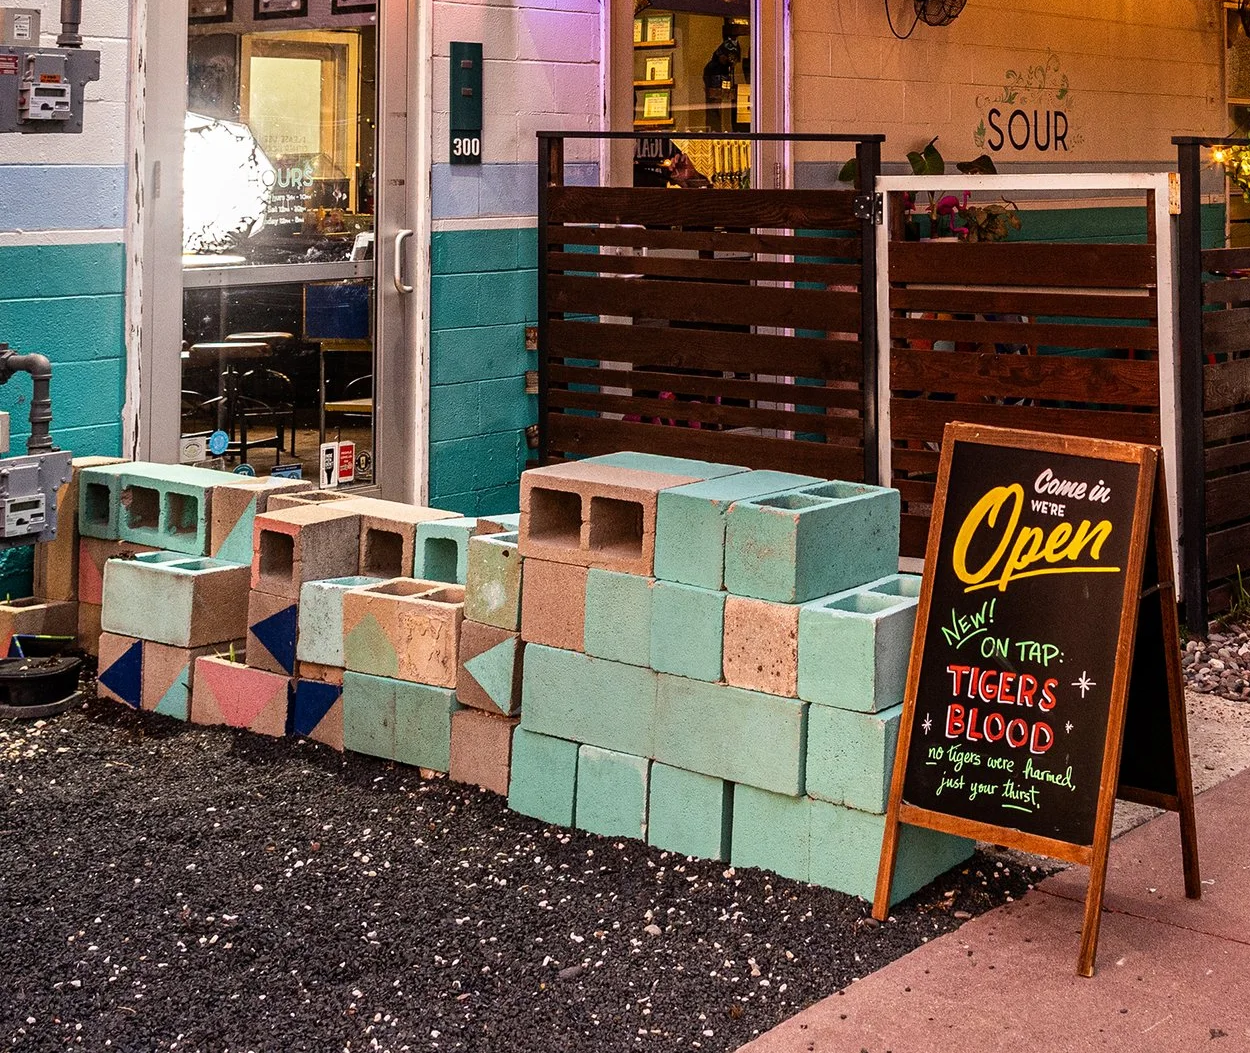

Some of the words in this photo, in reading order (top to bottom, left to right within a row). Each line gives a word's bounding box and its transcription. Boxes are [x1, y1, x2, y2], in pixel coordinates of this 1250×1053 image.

[453, 137, 480, 157] 300
[987, 108, 1068, 151] SOUR
[1034, 468, 1088, 500] Come
[1088, 479, 1111, 503] in
[1031, 499, 1066, 517] WE'RE
[952, 483, 1113, 592] Open
[941, 598, 997, 646] NEW!
[981, 636, 1009, 658] ON
[1015, 640, 1065, 667] TAP:
[946, 664, 1059, 712] TIGERS
[945, 703, 1055, 754] BLOOD
[928, 745, 944, 760] no
[946, 744, 981, 772] tigers
[987, 756, 1014, 772] were
[1023, 757, 1077, 791] harmed,
[936, 771, 965, 795] just
[970, 781, 998, 800] your
